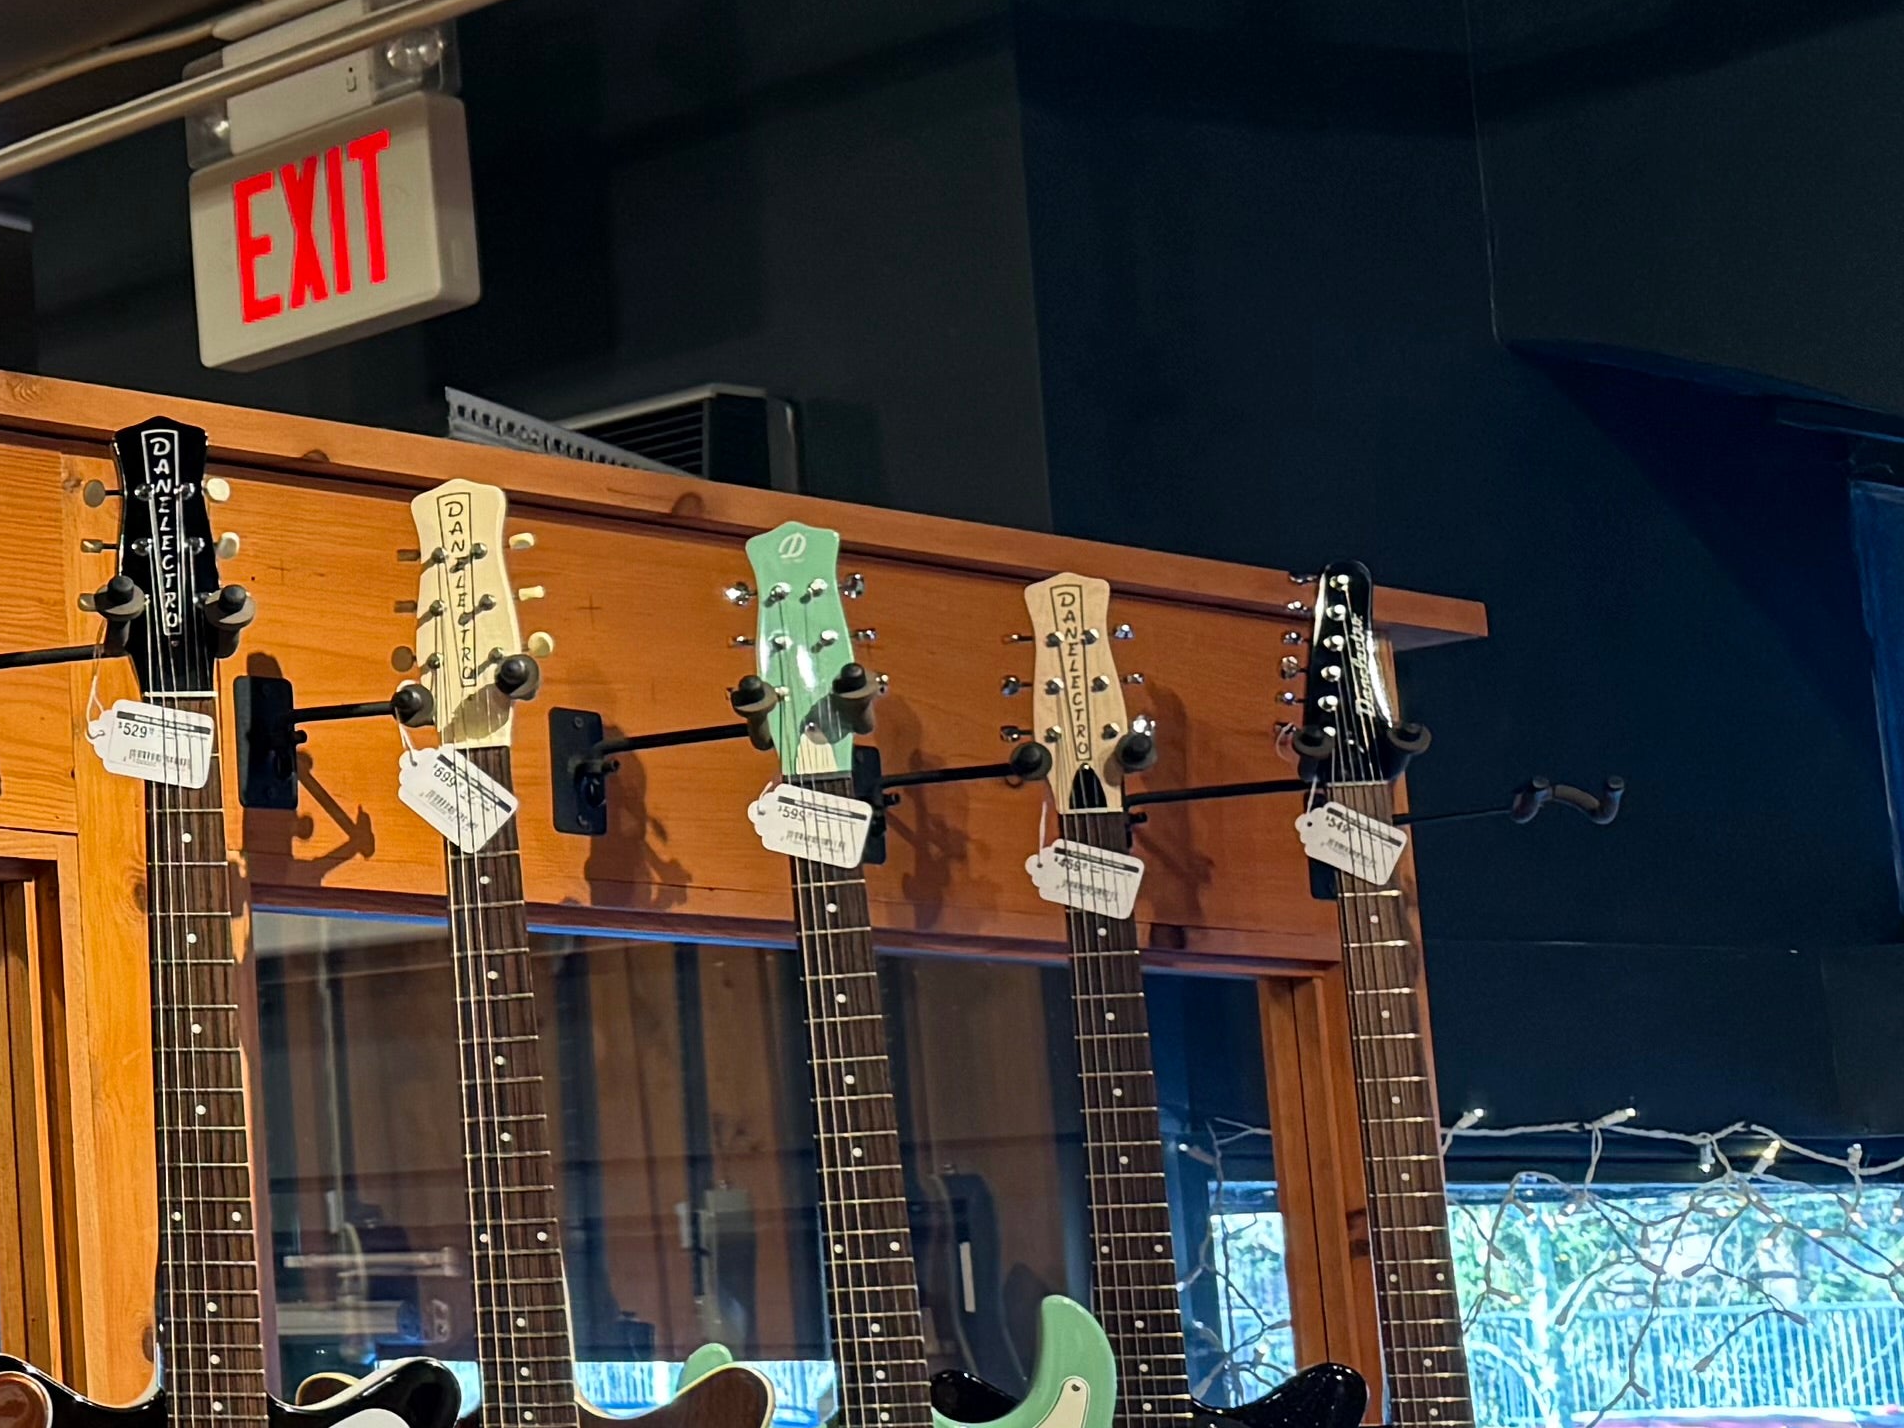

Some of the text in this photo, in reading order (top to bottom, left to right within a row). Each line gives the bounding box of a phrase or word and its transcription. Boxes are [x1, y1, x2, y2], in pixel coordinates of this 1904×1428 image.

[232, 128, 390, 325] EXIT
[149, 436, 178, 628] DANELECTRO
[118, 721, 148, 739] $529
[1056, 591, 1089, 755] DANELECTRO
